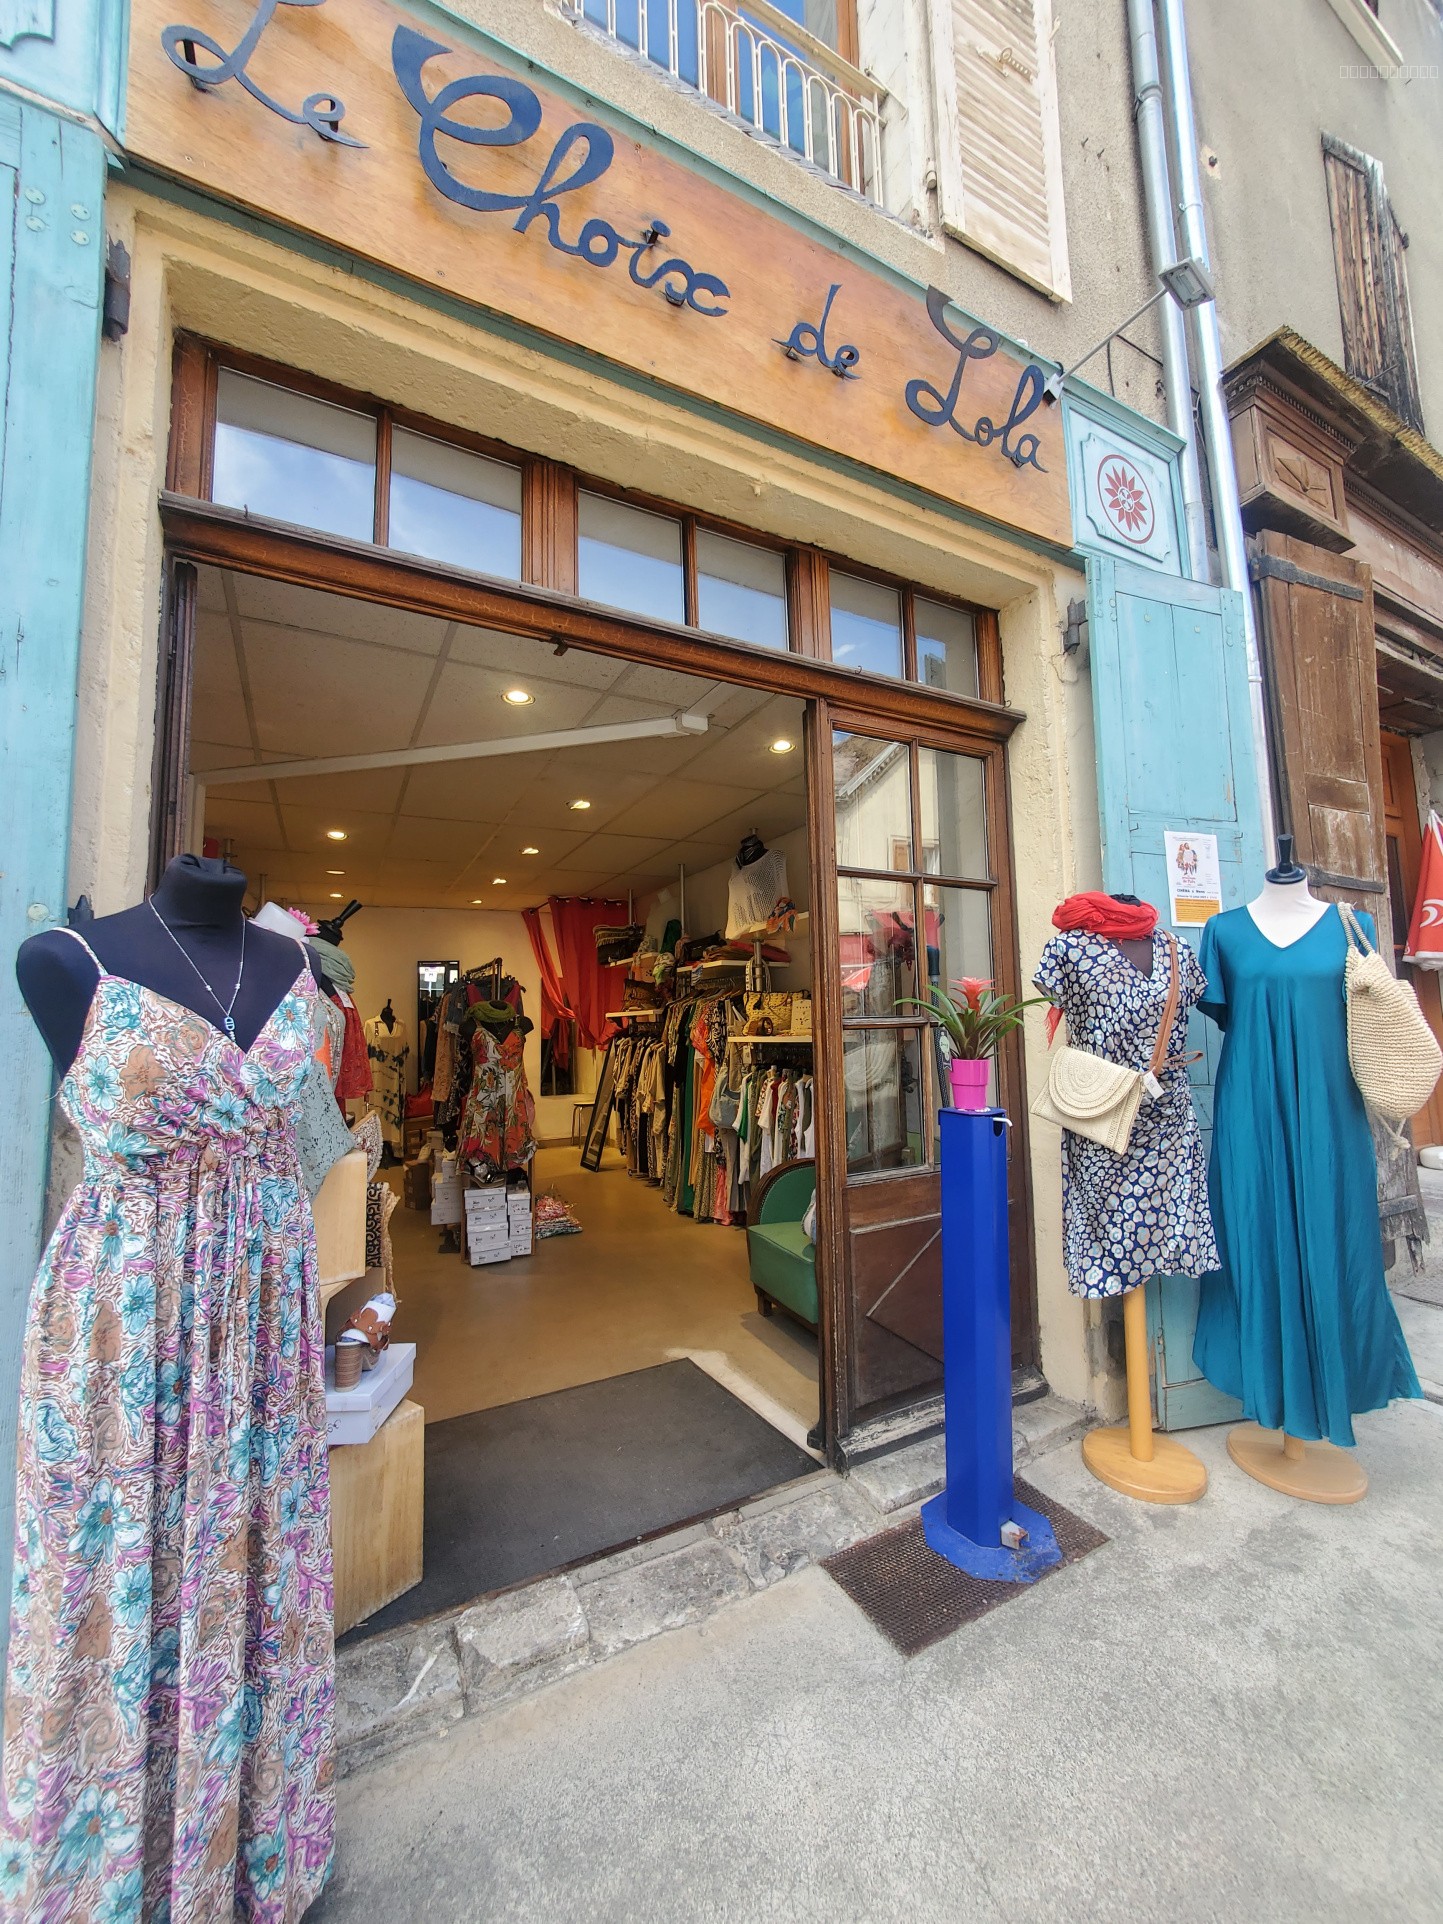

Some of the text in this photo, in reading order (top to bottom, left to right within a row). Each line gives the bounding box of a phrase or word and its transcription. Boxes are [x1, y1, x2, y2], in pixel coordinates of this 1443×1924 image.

[391, 24, 731, 317] Choix
[771, 284, 862, 380] de
[905, 284, 1049, 473] Lola
